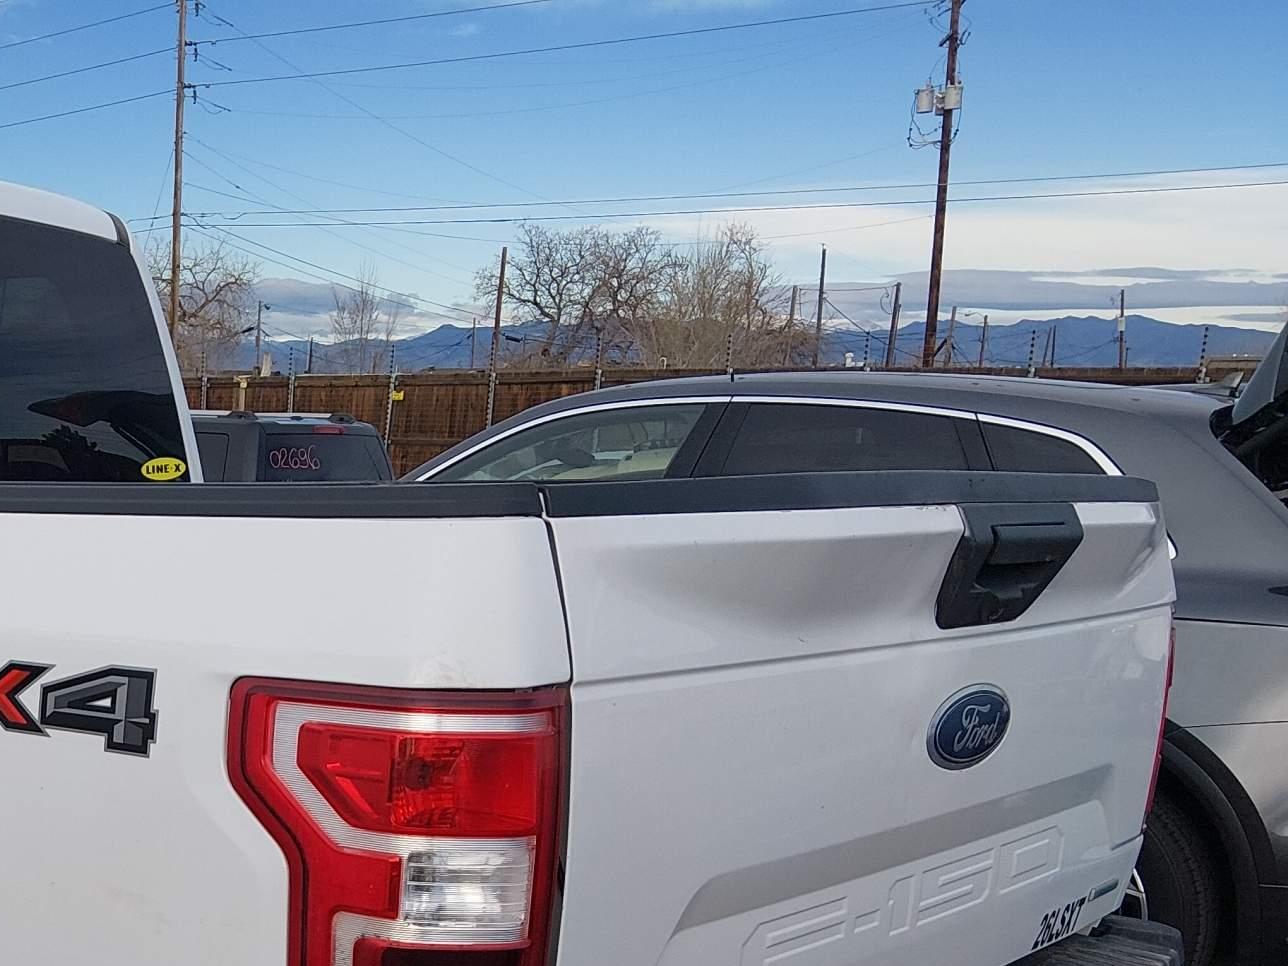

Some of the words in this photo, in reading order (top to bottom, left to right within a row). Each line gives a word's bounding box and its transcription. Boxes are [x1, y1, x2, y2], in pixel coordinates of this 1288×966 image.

[269, 445, 321, 470] 02696
[953, 704, 1001, 753] Ford
[1031, 895, 1088, 951] 26LSXT
